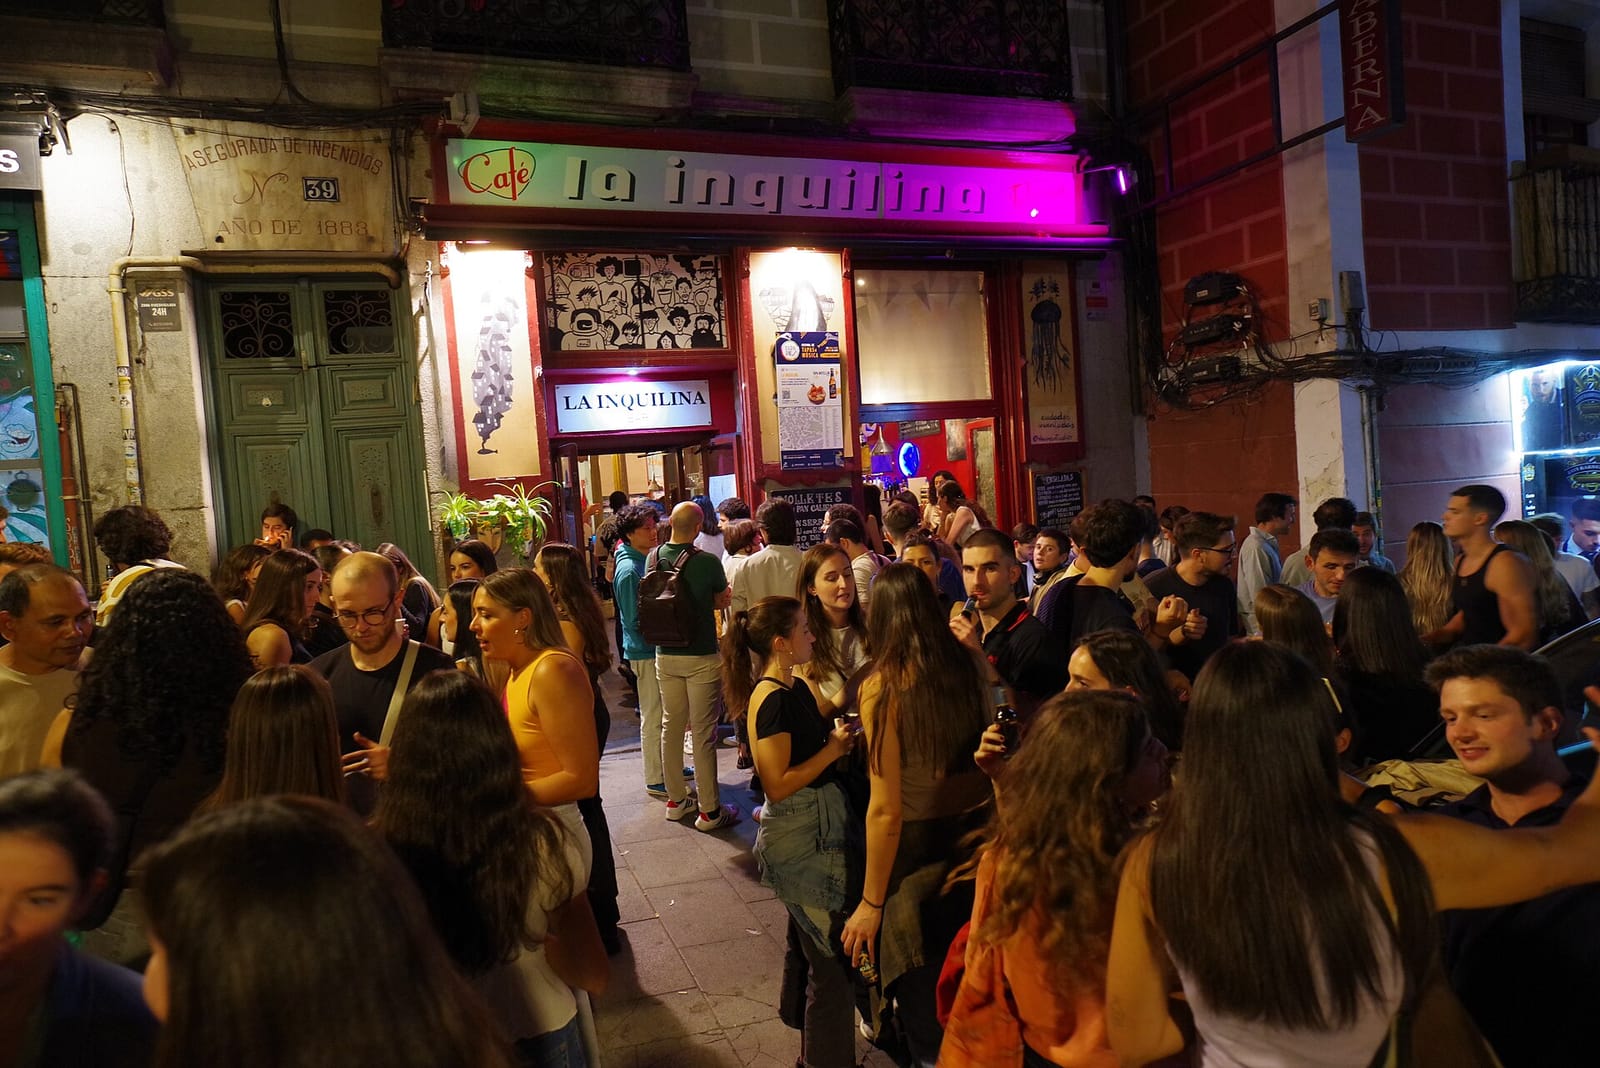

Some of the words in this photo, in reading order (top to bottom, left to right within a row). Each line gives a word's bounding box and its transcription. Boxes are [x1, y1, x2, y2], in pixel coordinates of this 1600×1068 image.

[184, 138, 278, 171] ASEGURADA
[283, 137, 302, 154] DE
[306, 139, 383, 175] INCENDIOS
[463, 147, 530, 200] Café
[306, 180, 336, 199] 39
[564, 156, 636, 202] la
[665, 155, 985, 215] inquilina
[218, 217, 262, 235] AÑO
[271, 220, 301, 235] DE
[152, 307, 167, 316] 24H
[563, 394, 593, 410] LA
[597, 390, 706, 411] INQUILINA
